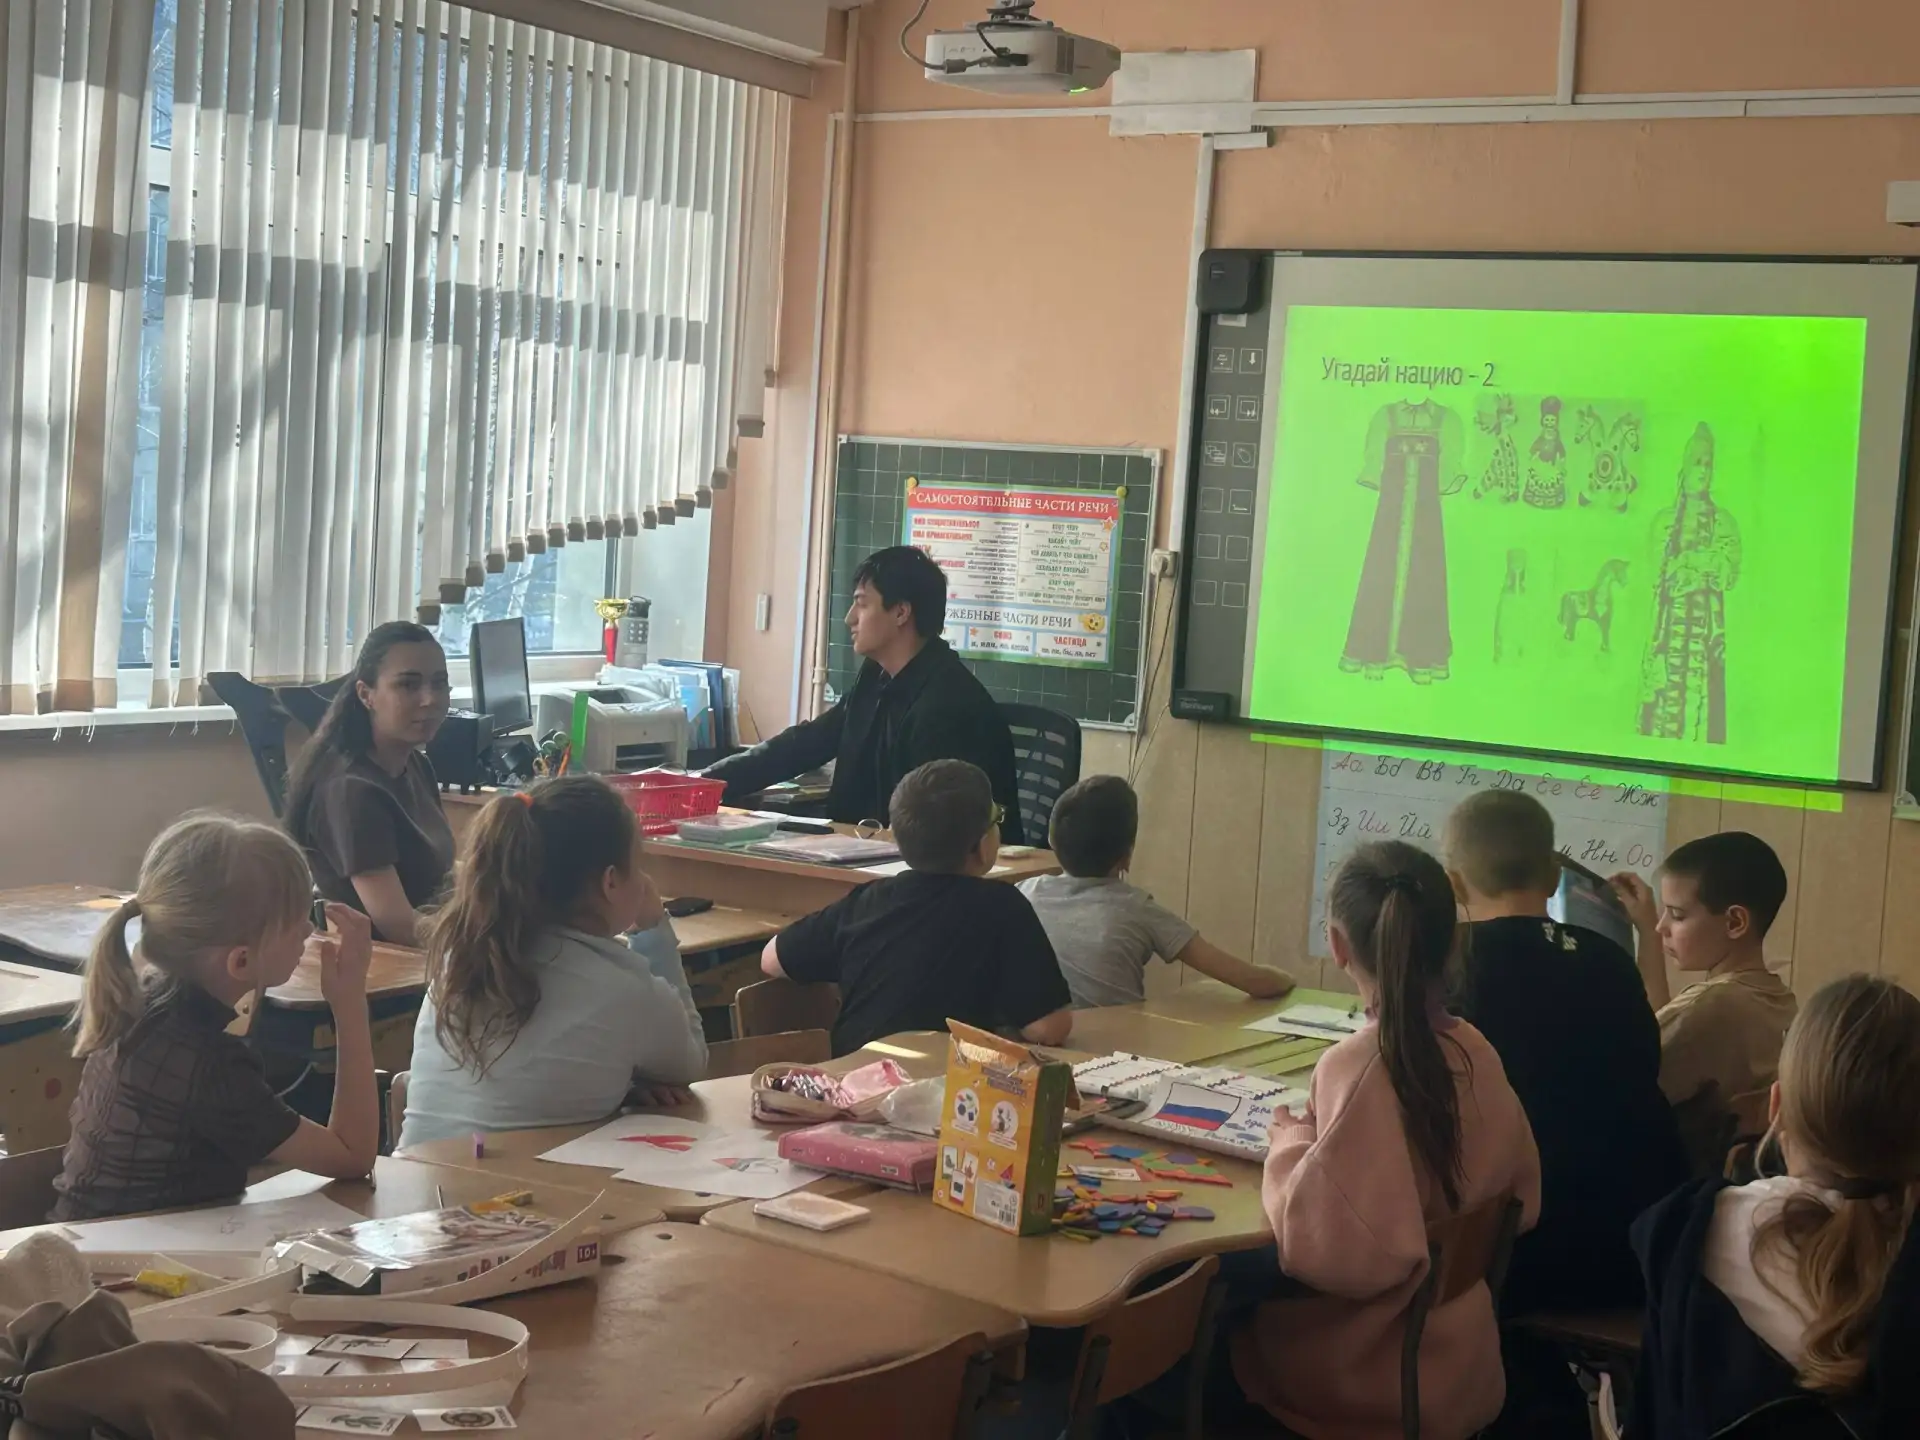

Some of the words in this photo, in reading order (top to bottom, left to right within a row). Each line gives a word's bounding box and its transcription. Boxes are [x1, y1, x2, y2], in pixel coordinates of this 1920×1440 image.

[1321, 356, 1390, 388] Угадай
[1395, 364, 1463, 390] нацию
[1482, 362, 1496, 387] 2
[916, 492, 1032, 508] САМОСТОЯТЕЛЬНЫЕ
[1034, 498, 1075, 512] ЧАСТИ
[1078, 501, 1109, 513] РЕЧИ
[945, 607, 1001, 622] УЖЕБНЫЕ
[1003, 611, 1039, 625] ЧАСТИ
[1042, 615, 1072, 628] РЕЧИ
[1331, 751, 1363, 774] Аа
[1374, 754, 1408, 778] Бб
[1416, 759, 1445, 782] Вв
[1614, 782, 1660, 807] Жж
[1357, 809, 1391, 834] Ии
